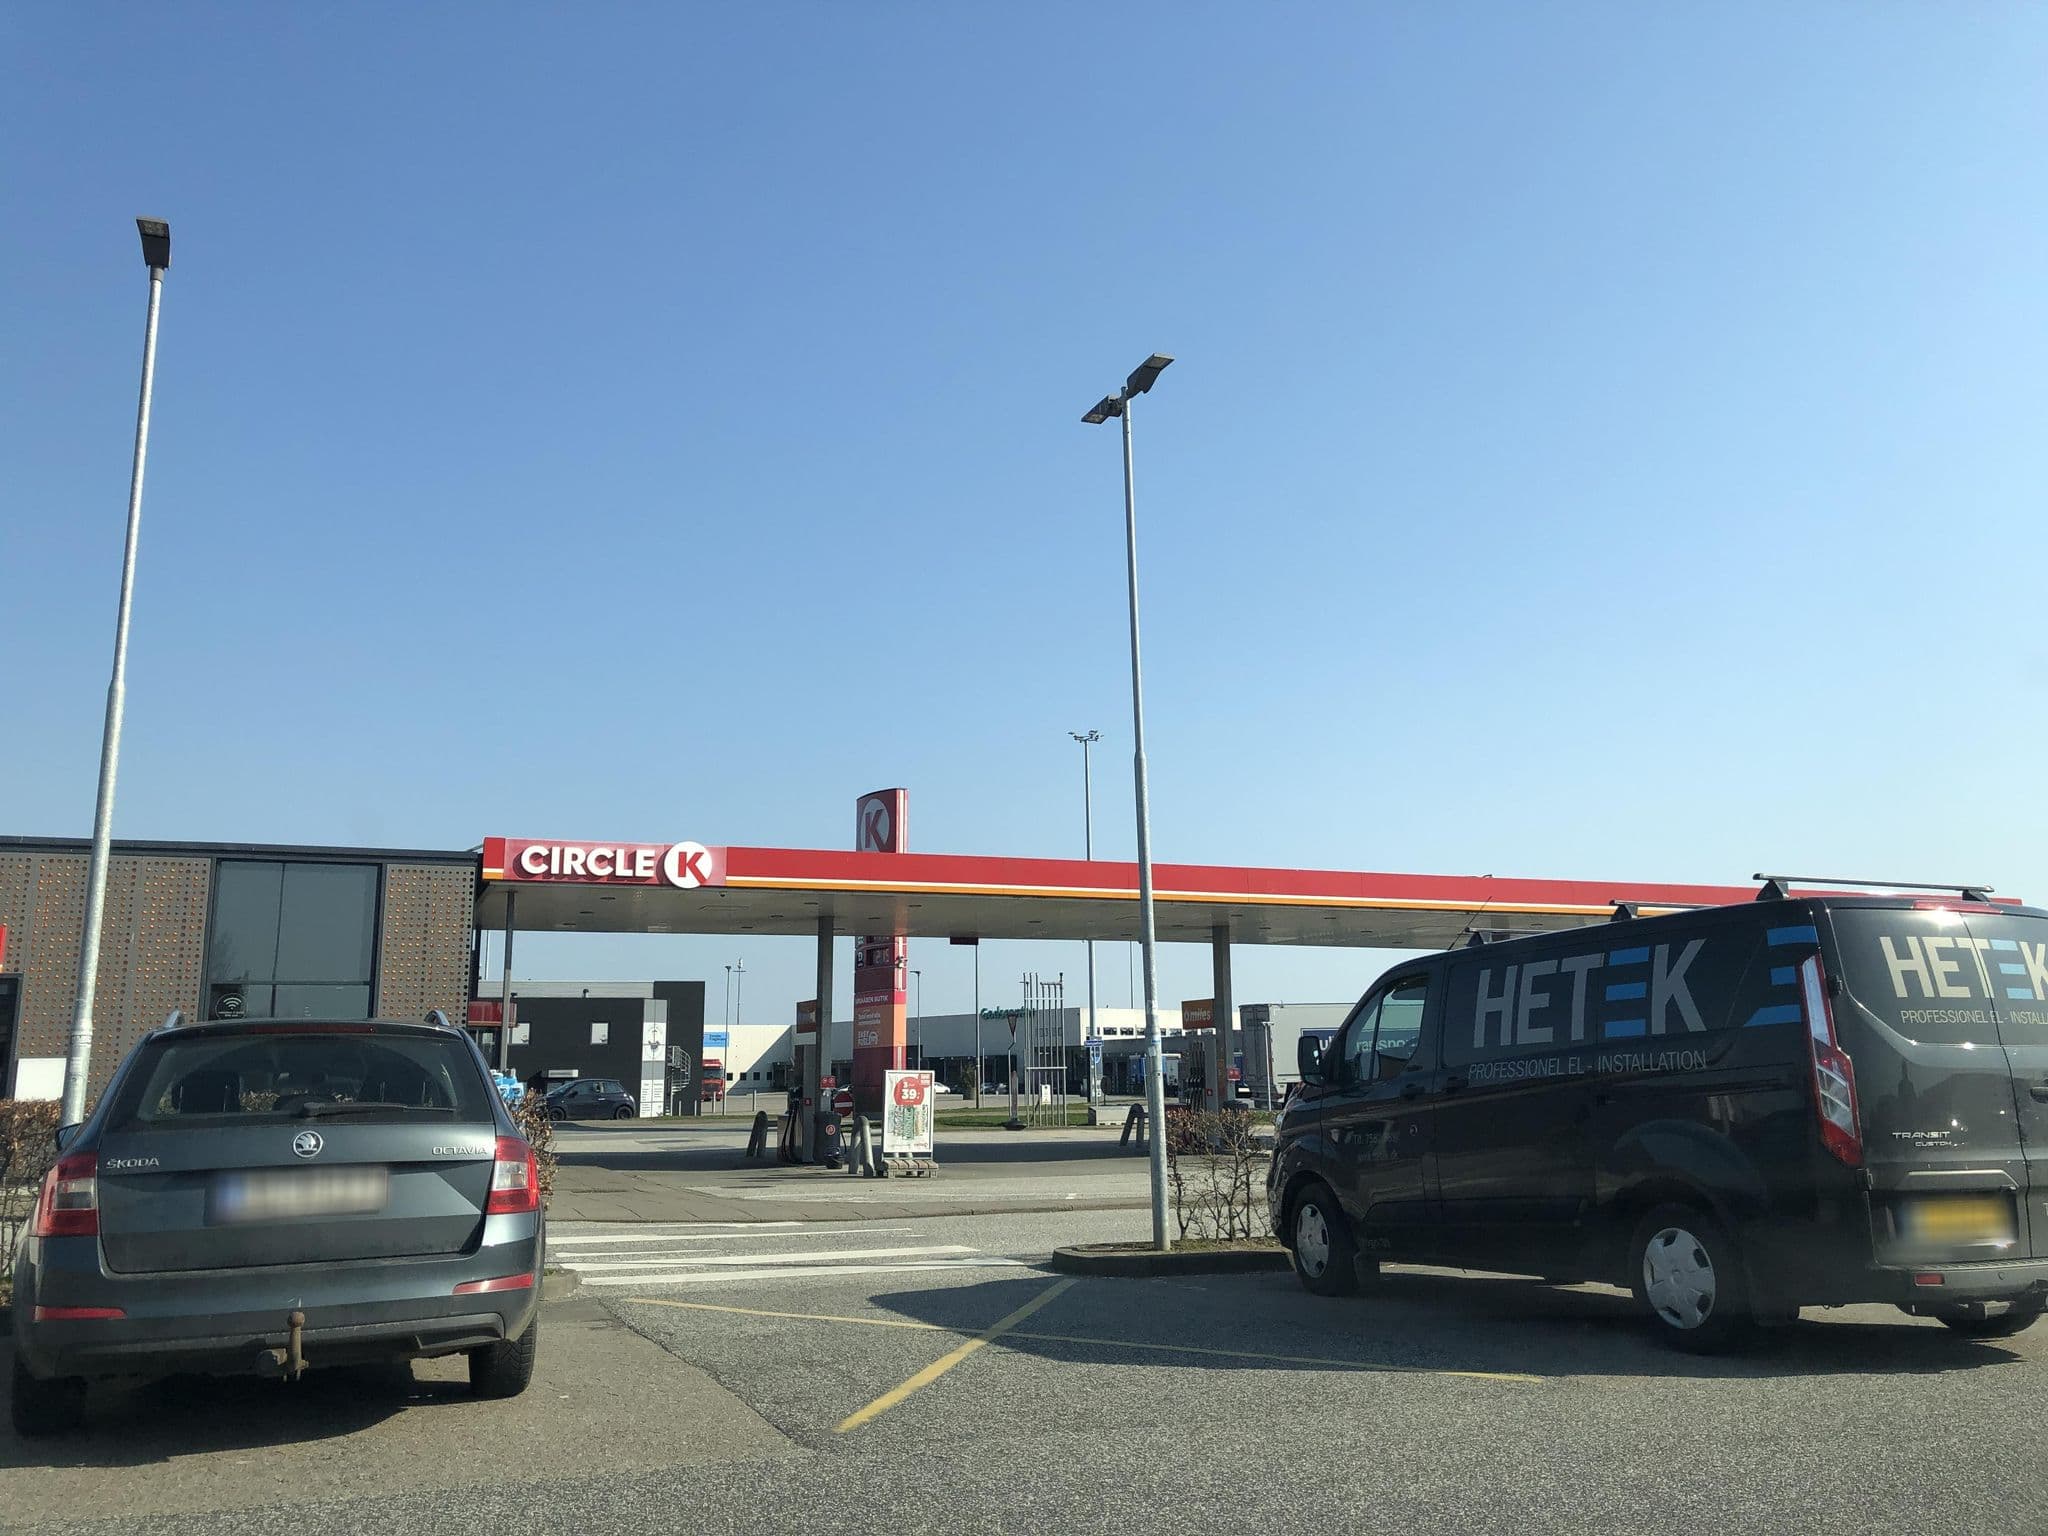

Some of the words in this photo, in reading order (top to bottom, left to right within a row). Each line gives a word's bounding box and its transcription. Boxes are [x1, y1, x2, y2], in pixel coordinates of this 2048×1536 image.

[864, 809, 887, 852] K
[520, 845, 656, 877] CIRCLE
[677, 851, 708, 884] K
[1879, 936, 2048, 1001] HETEK
[1473, 938, 1708, 1049] HETEK
[1900, 1009, 1988, 1024] PROFESSIONEL
[1989, 1010, 2003, 1024] EL
[1468, 1057, 1564, 1080] PROFESSIONEL
[1568, 1056, 1585, 1075] EL
[1597, 1049, 1708, 1073] INSTALLATION
[432, 1146, 488, 1156] OCTAVIA
[1892, 1131, 1951, 1139] TRANSIT
